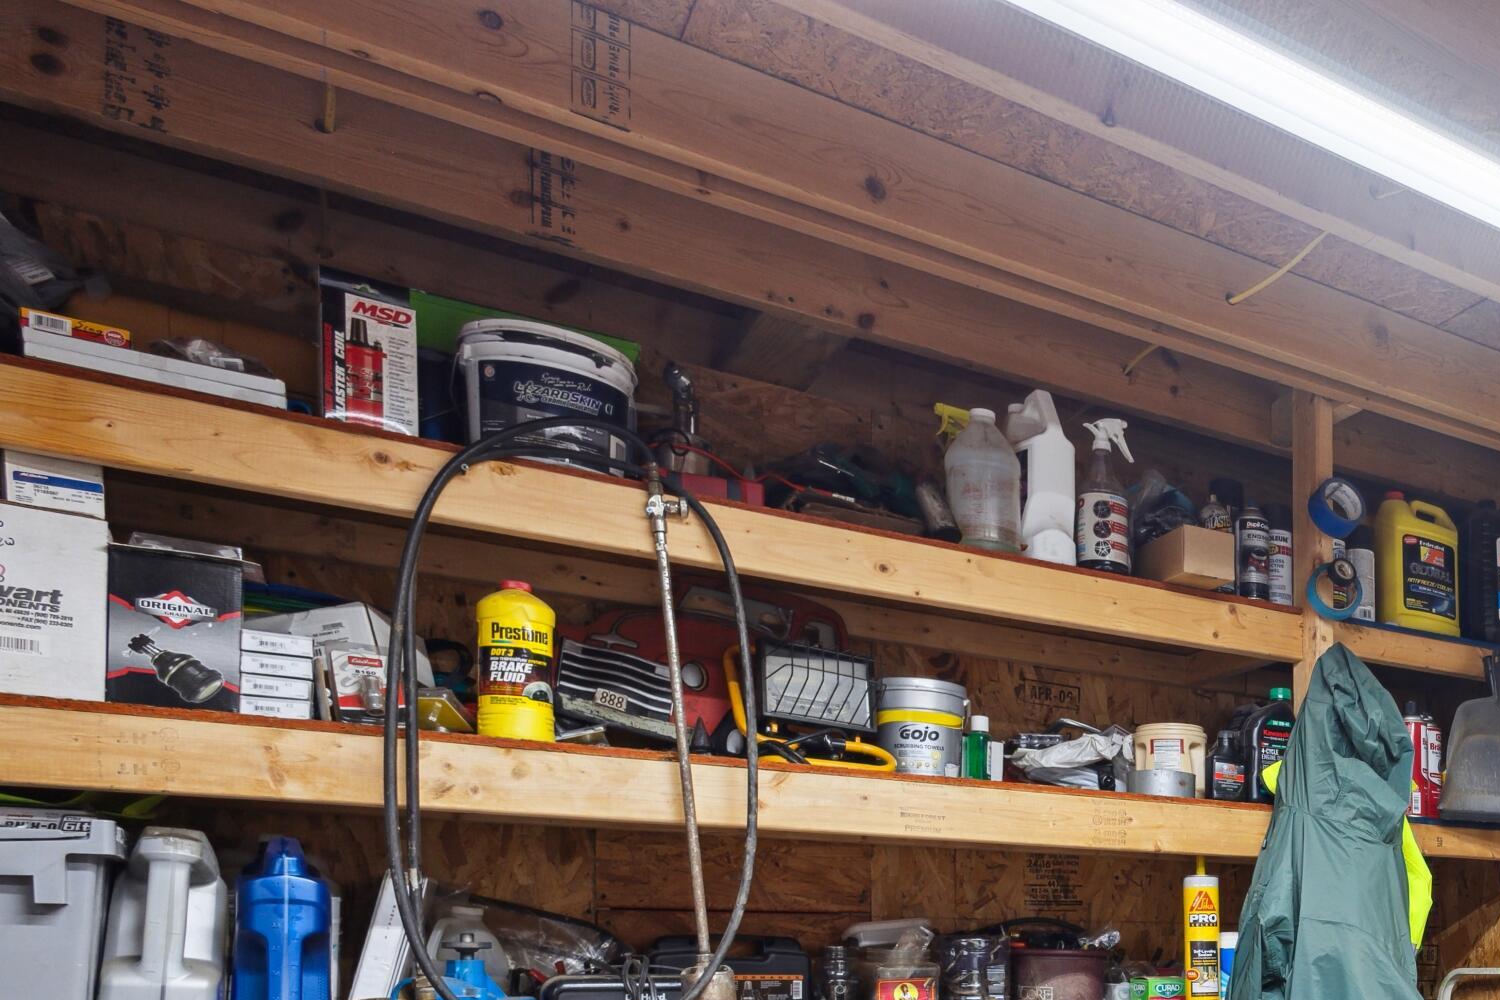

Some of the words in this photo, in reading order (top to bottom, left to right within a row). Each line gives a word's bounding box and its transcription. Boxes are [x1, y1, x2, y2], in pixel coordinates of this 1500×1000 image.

[352, 301, 412, 324] MSD
[334, 330, 345, 359] COIL
[139, 599, 213, 616] ORIGINAL
[491, 622, 548, 645] Prestone
[490, 648, 505, 656] DOT
[490, 660, 533, 673] BRAKE
[490, 671, 526, 683] FLUID
[600, 691, 625, 709] 888
[899, 725, 940, 742] GOJO
[924, 744, 945, 752] TOWELS
[1190, 914, 1218, 923] PRO
[1155, 984, 1180, 993] CURAD
